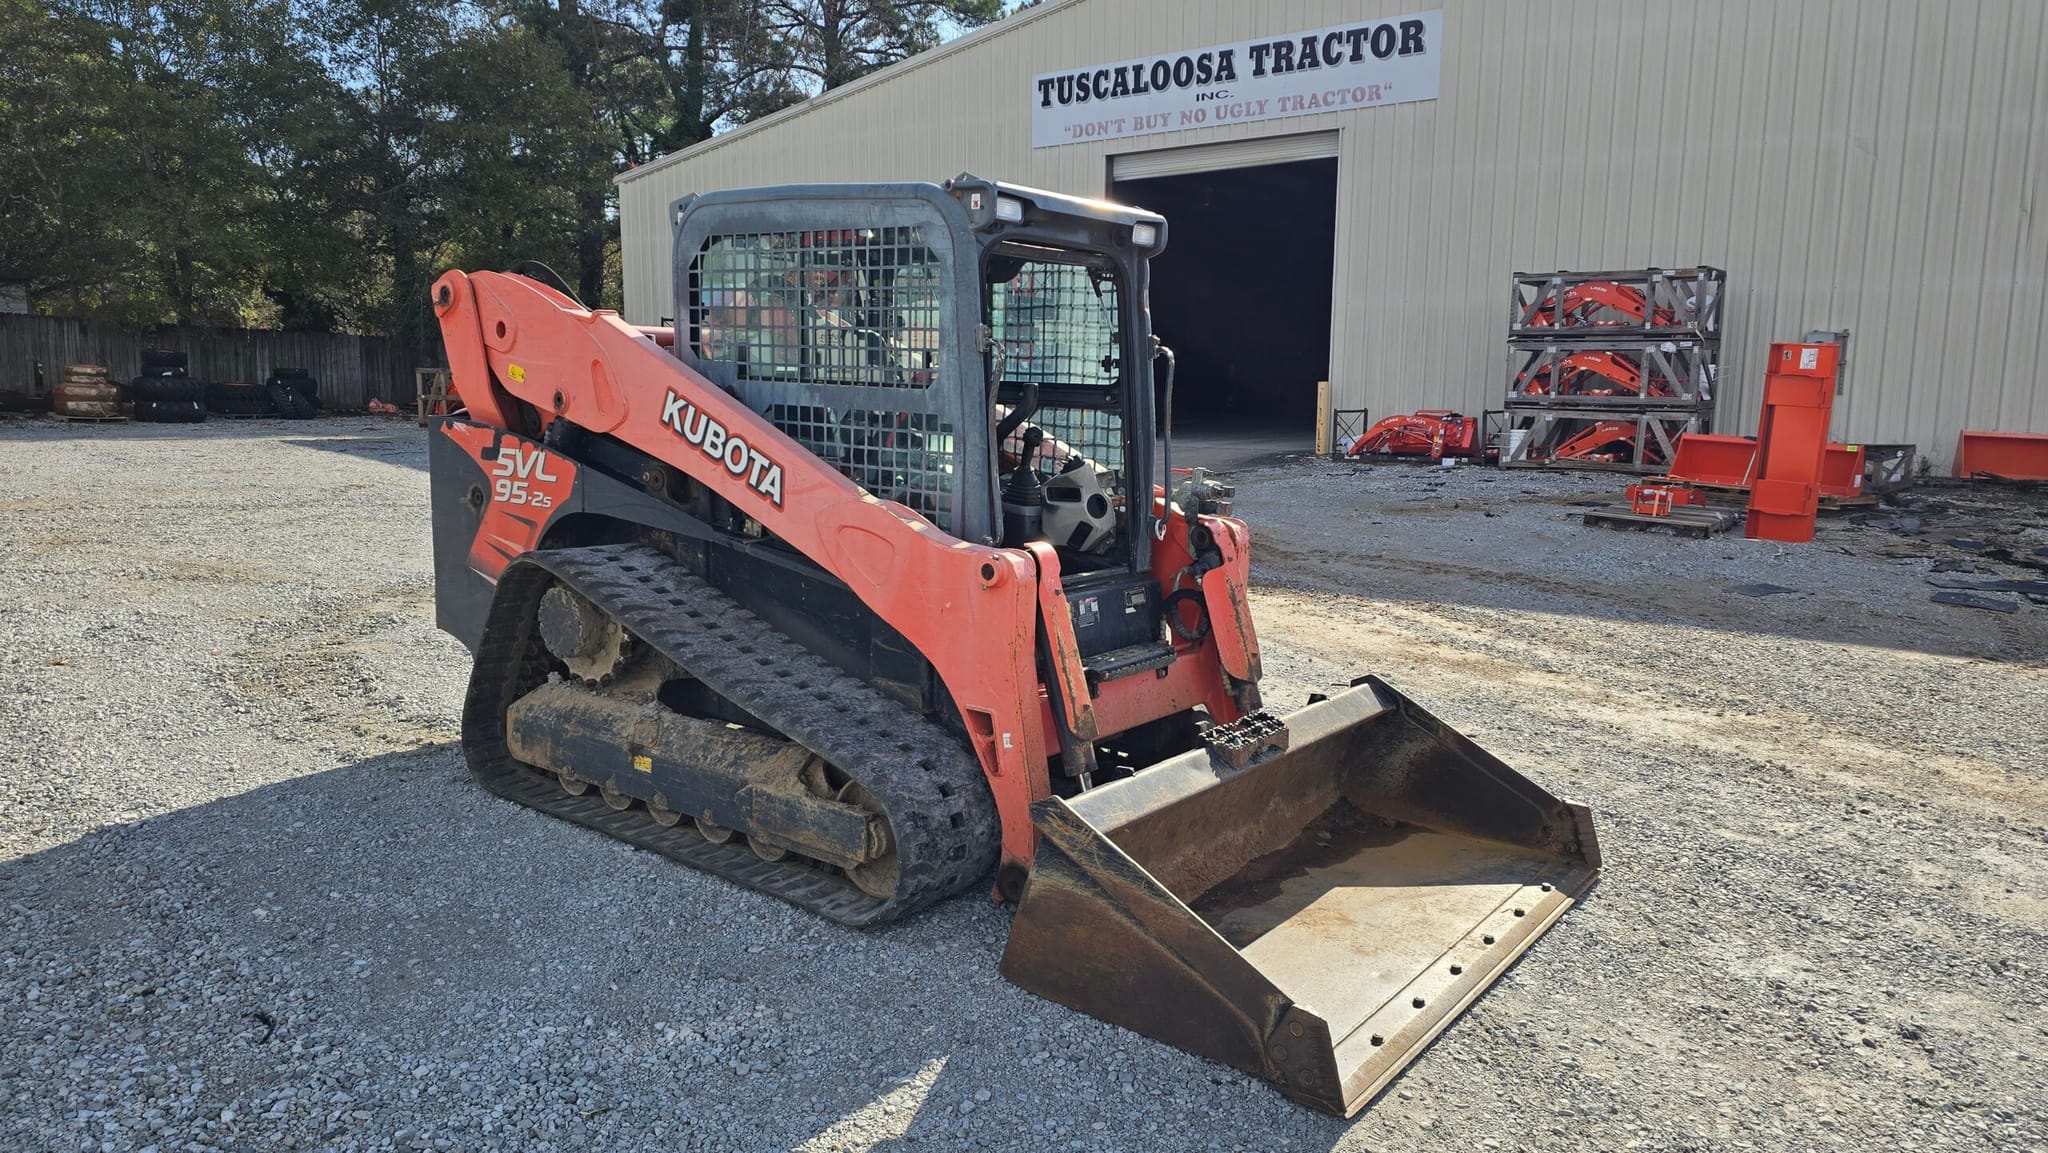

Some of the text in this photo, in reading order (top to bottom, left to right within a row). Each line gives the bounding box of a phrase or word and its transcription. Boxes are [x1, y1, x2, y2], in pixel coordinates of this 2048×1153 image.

[1038, 19, 1425, 108] TUSCALOOSA TRACTOR
[1195, 90, 1235, 102] INC.
[1133, 112, 1172, 132] BUY
[1179, 107, 1207, 126] NO
[1214, 98, 1270, 121] UGLY
[492, 447, 557, 483] SVL
[660, 388, 783, 507] KUBOTA
